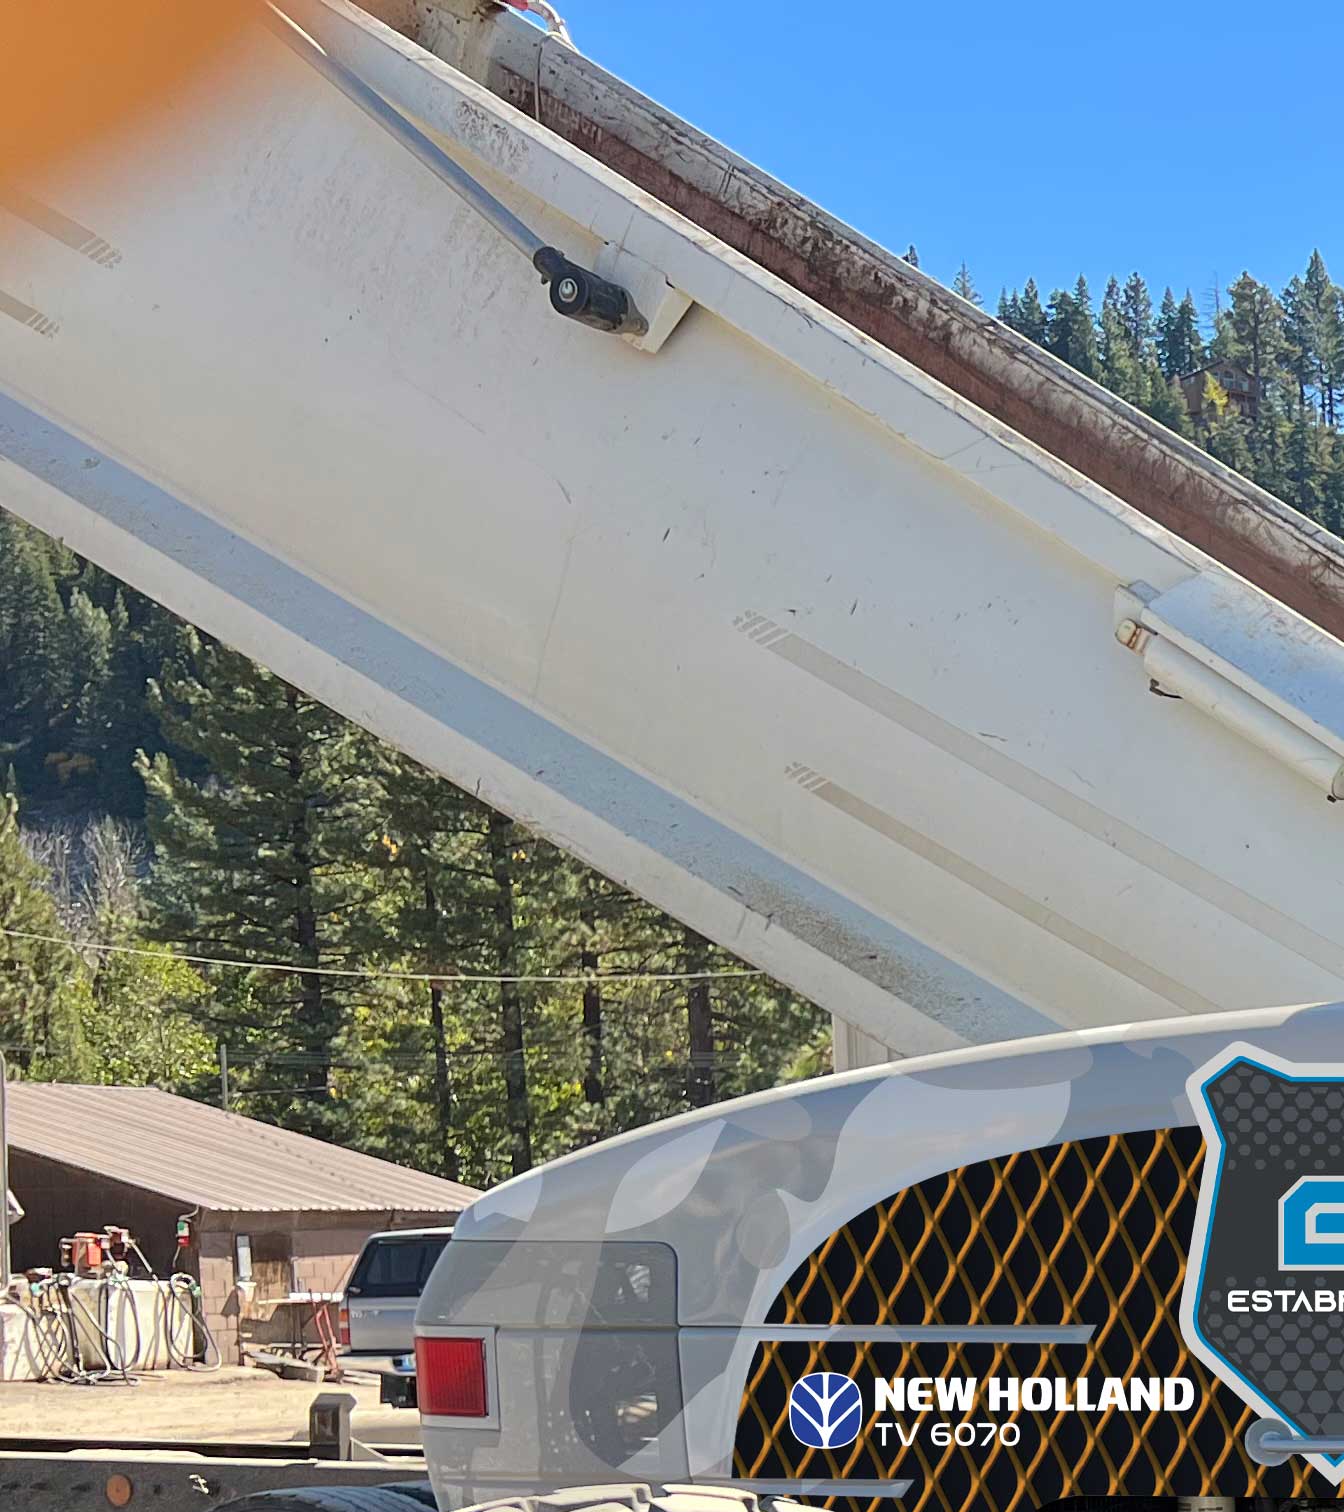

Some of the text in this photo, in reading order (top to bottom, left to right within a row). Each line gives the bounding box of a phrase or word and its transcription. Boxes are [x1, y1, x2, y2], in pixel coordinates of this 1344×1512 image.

[875, 1378, 1194, 1411] NEW HOLLAND
[875, 1423, 1020, 1446] TV 6070
